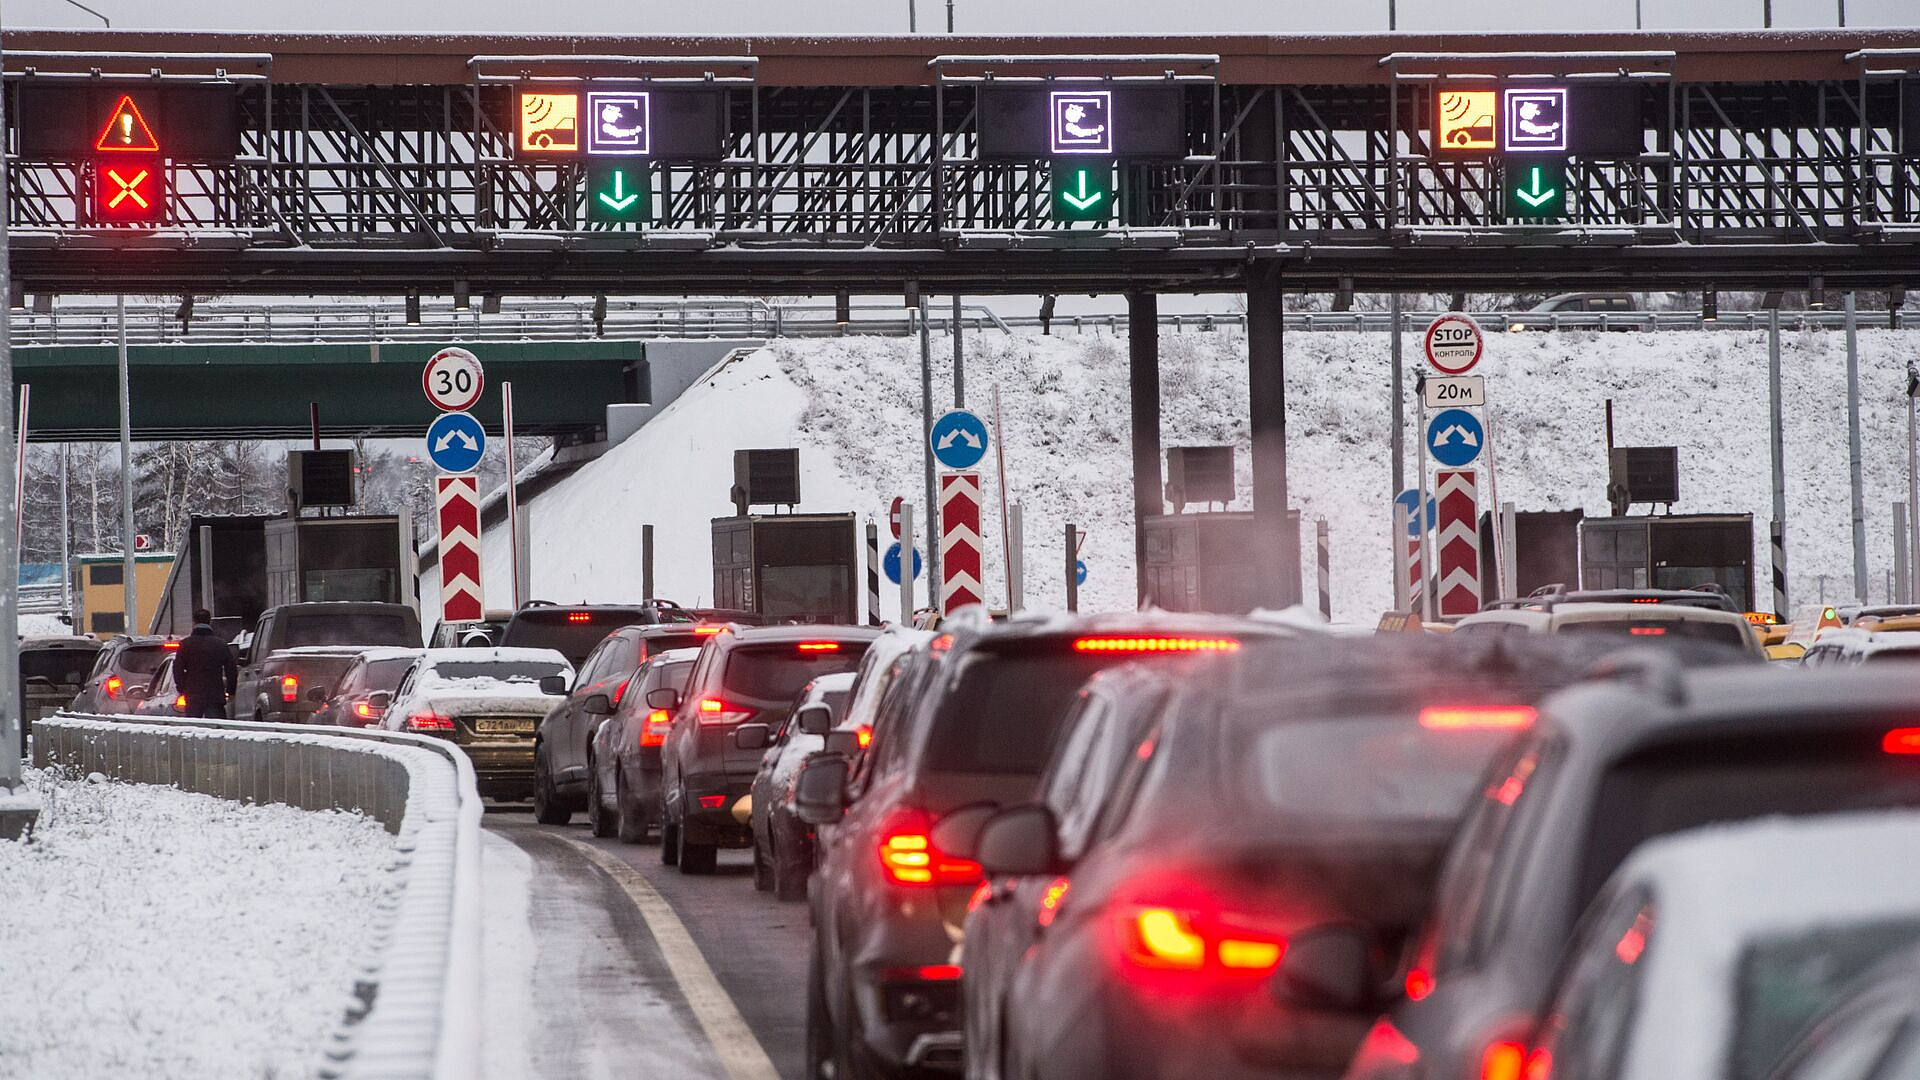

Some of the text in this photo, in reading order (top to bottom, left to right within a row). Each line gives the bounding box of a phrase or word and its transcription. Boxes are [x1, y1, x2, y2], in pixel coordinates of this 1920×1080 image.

[1434, 329, 1473, 341] STOP
[1434, 349, 1475, 358] КОНТРОЛЬ
[436, 368, 472, 396] 30
